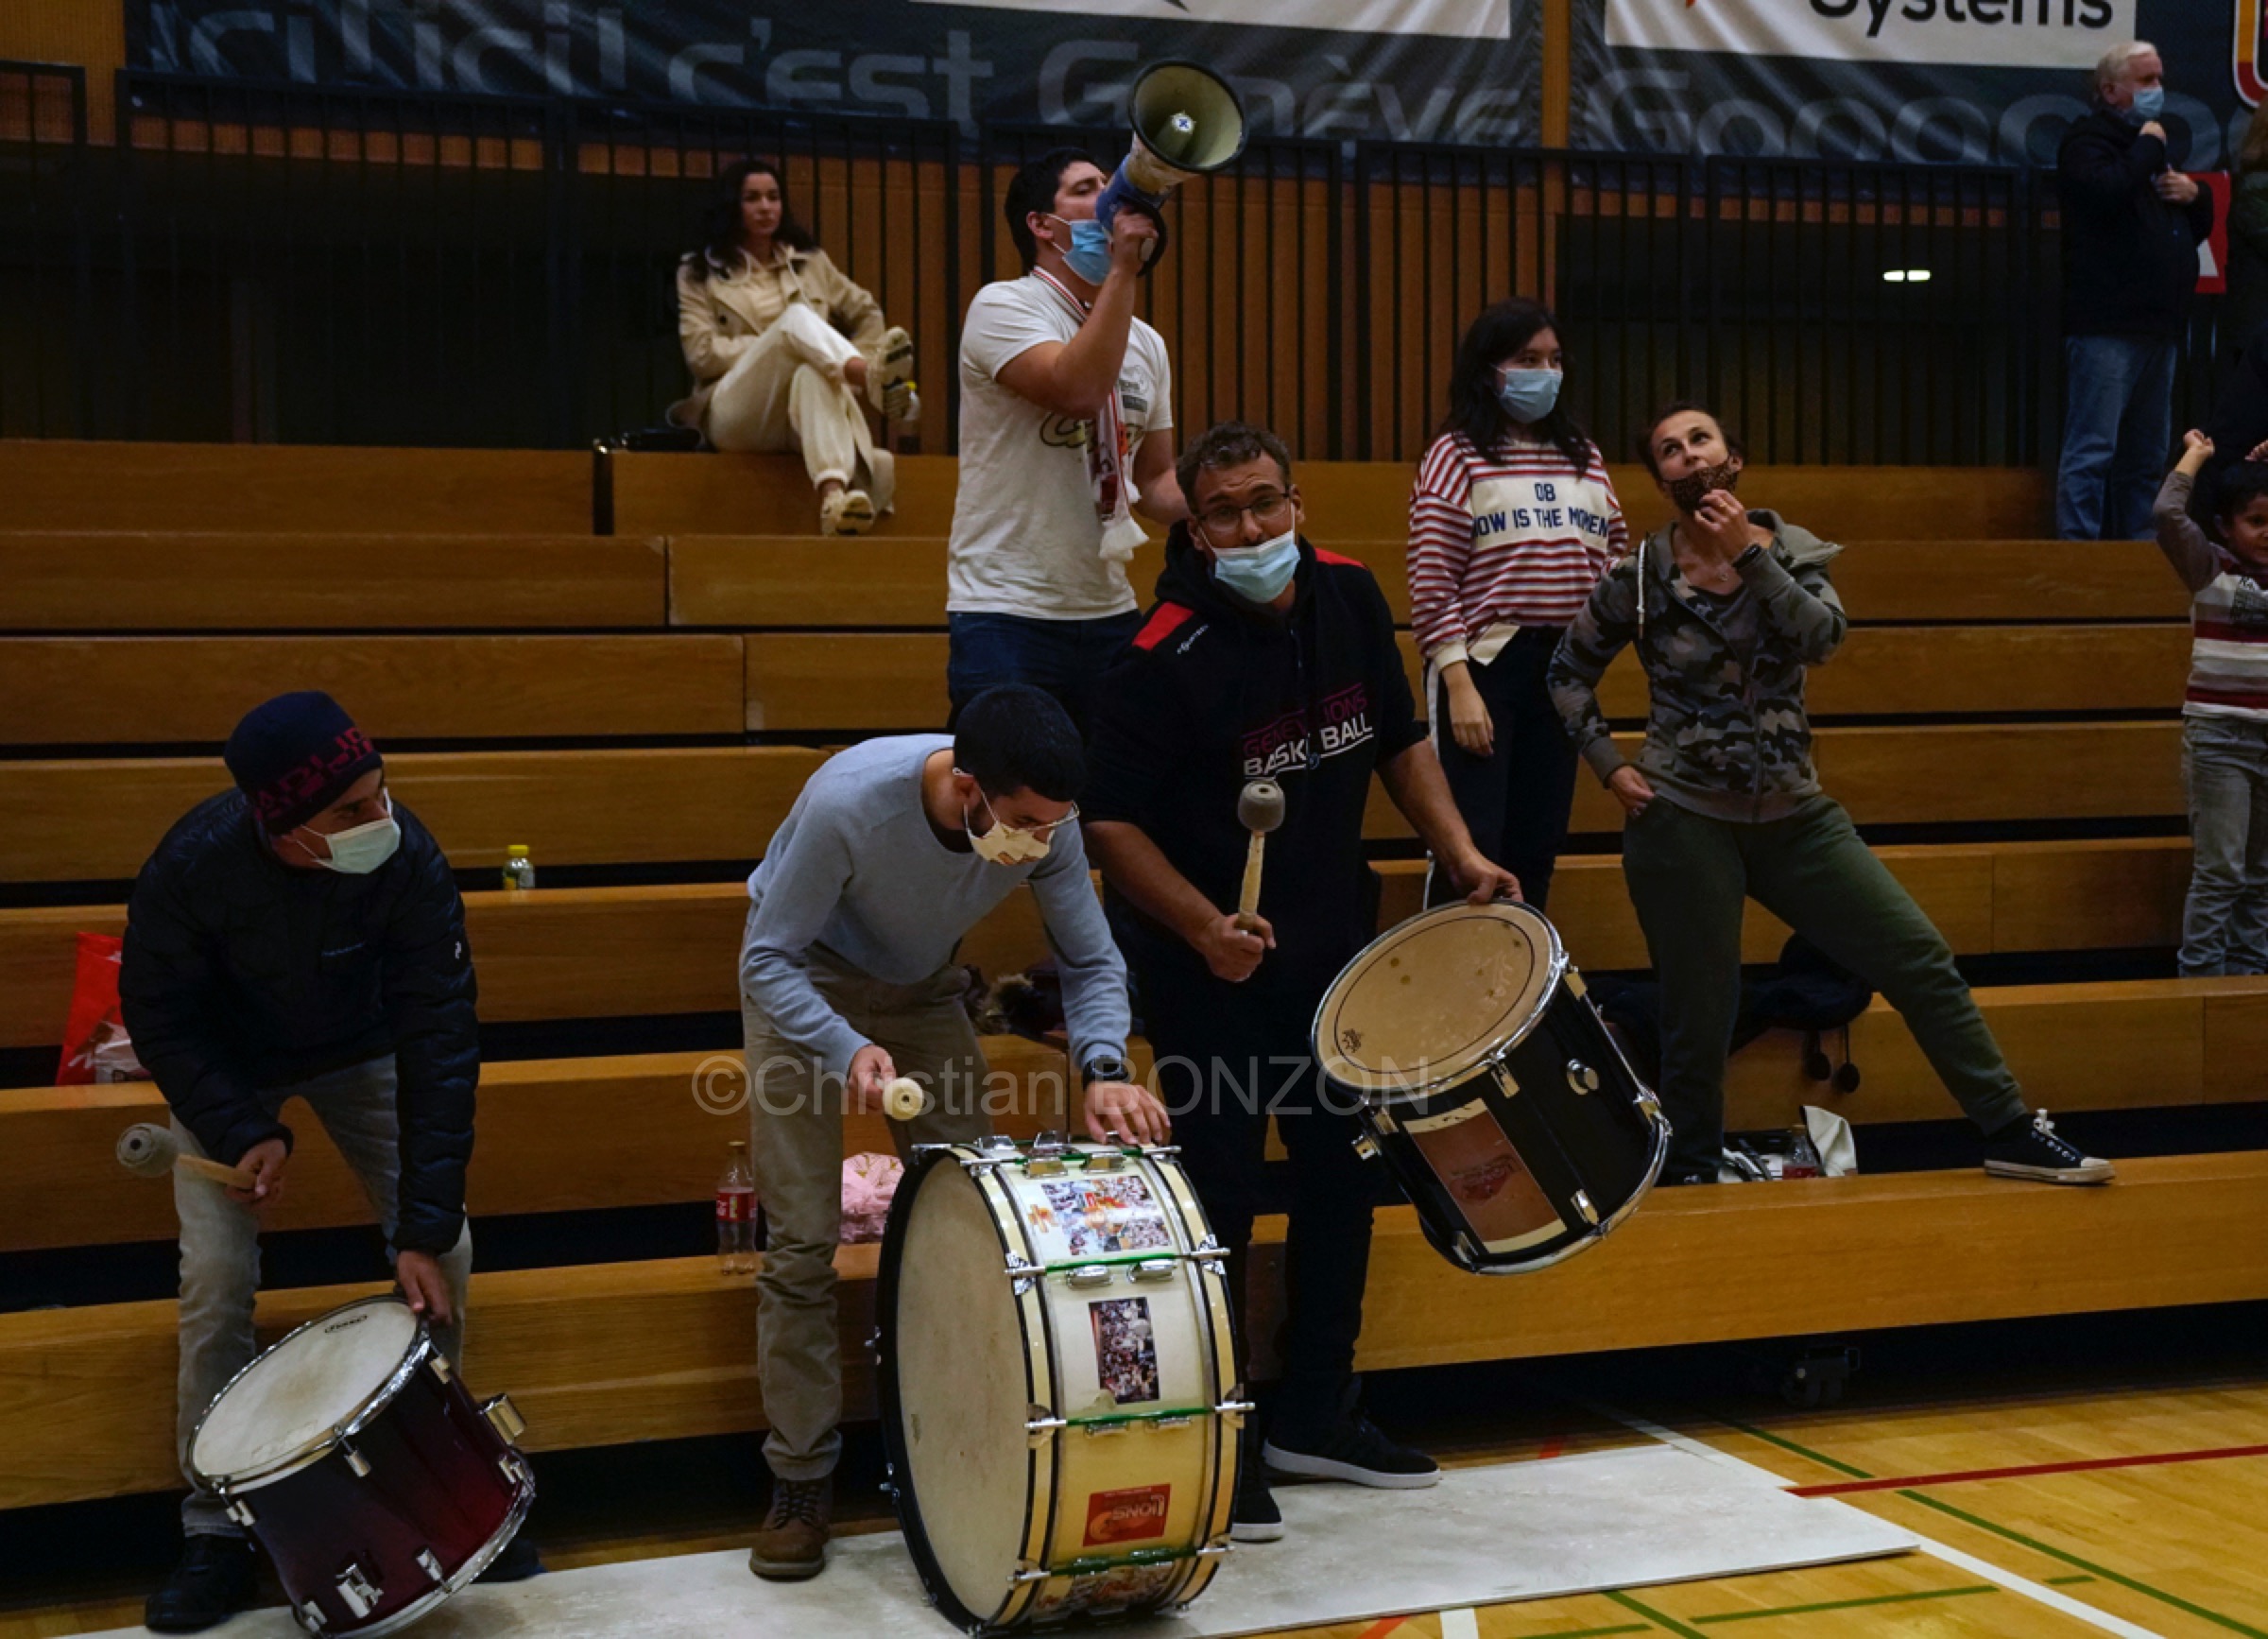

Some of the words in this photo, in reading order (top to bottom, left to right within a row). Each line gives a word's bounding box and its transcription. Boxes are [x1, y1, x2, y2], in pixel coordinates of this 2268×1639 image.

[1038, 39, 1522, 146] Gnève
[1512, 508, 1530, 529] IS
[1533, 508, 1563, 528] THE
